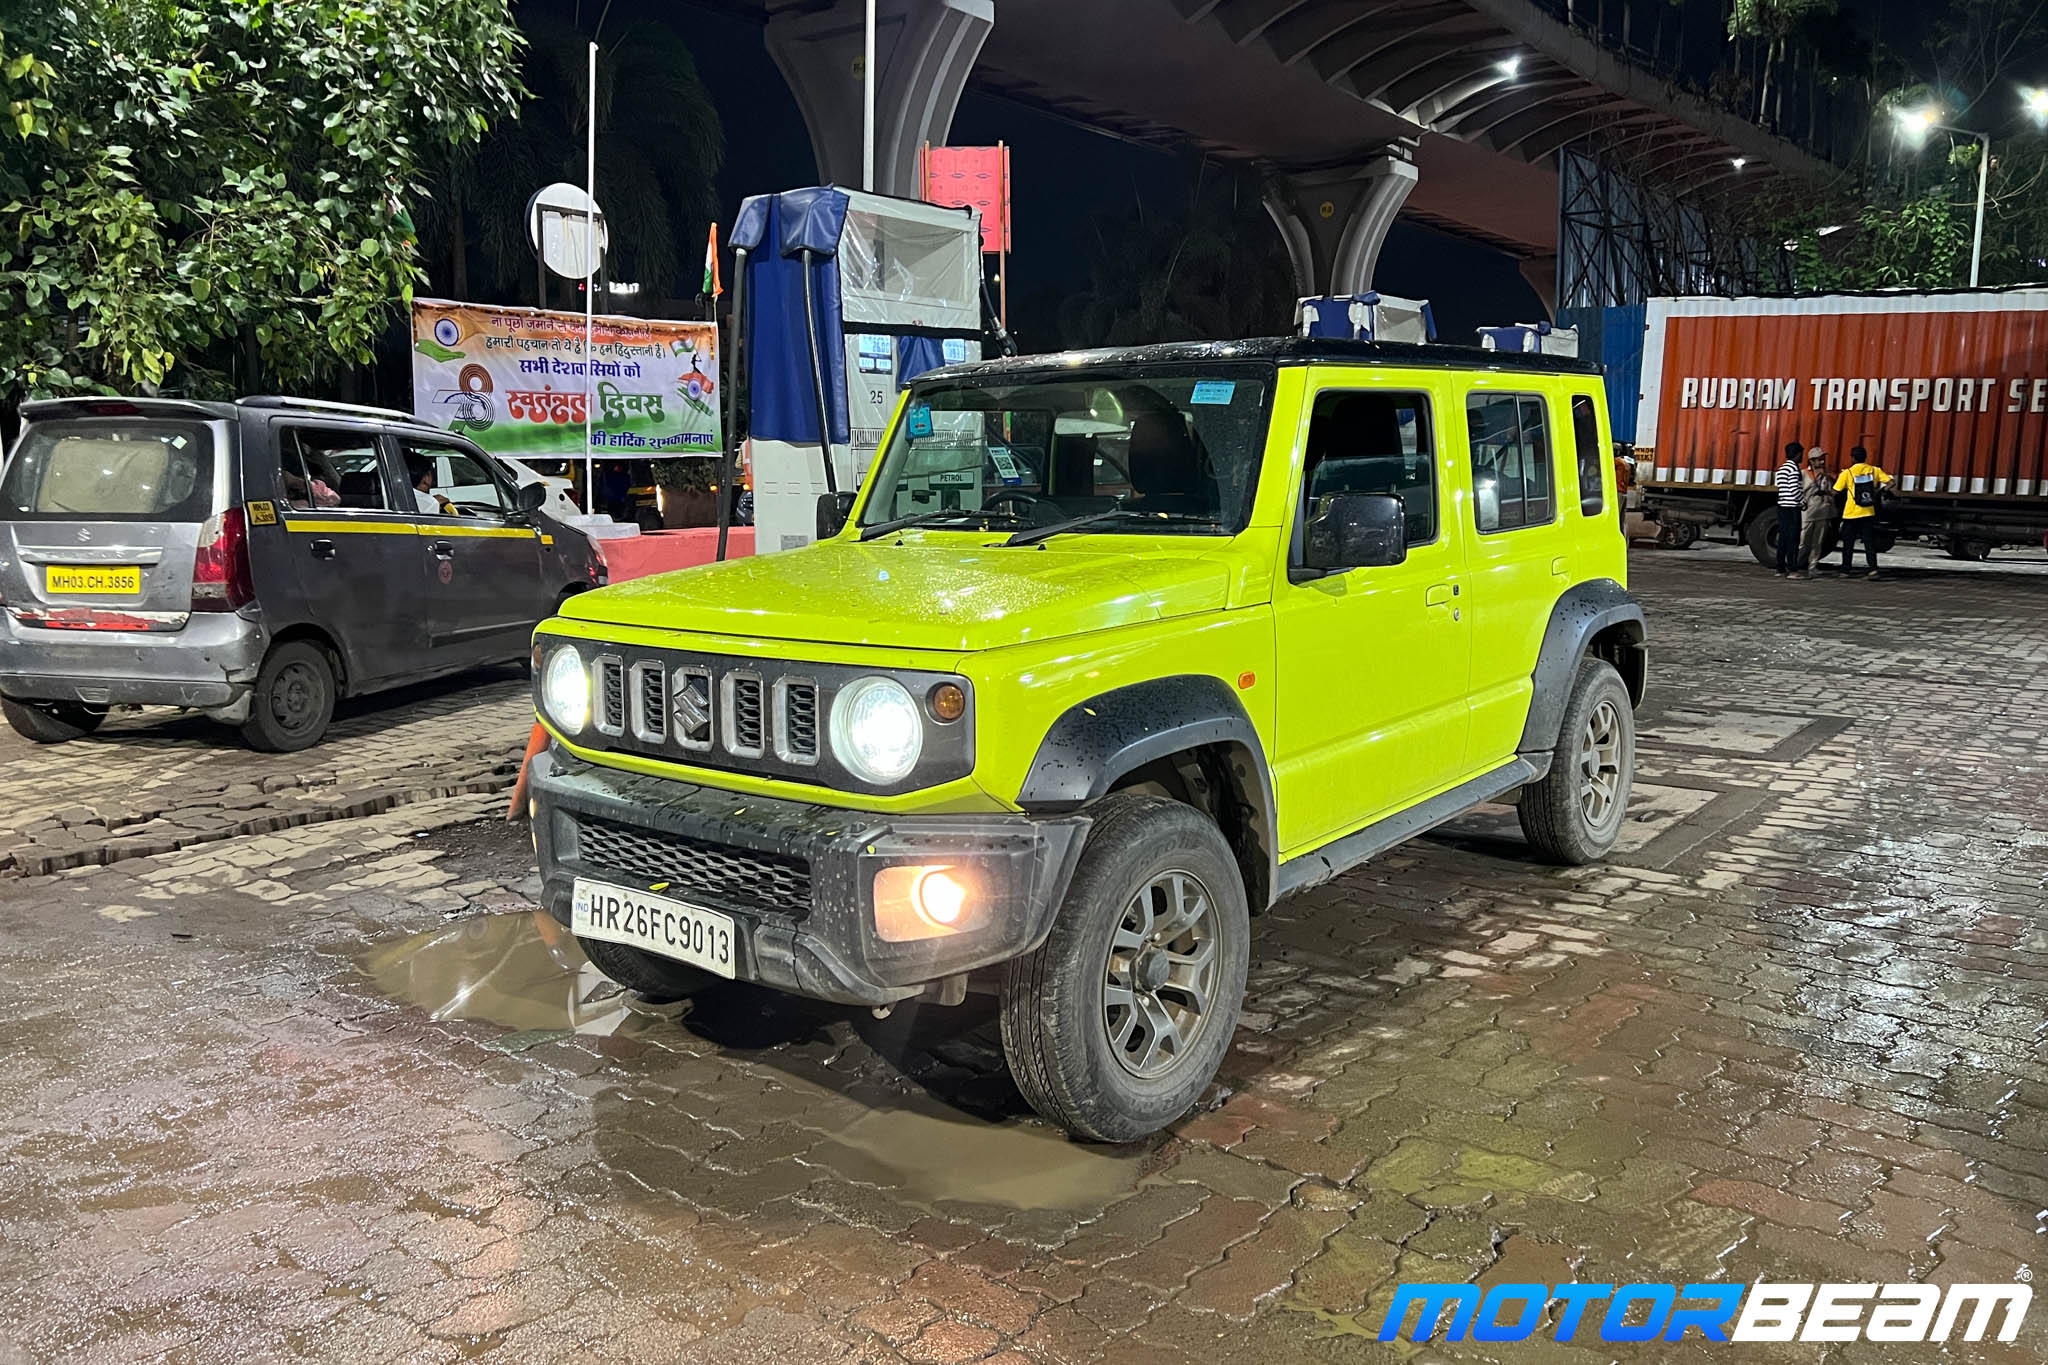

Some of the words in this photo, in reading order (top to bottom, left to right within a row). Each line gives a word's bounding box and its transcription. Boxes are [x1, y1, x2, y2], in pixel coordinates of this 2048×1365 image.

[485, 335, 513, 350] हमारी
[516, 337, 549, 352] पहचान
[551, 337, 562, 351] तो
[564, 338, 572, 351] ये
[574, 336, 582, 354] है
[599, 343, 613, 356] हम
[519, 357, 549, 375] सभी
[623, 361, 641, 378] को
[597, 381, 665, 426] दिवस
[870, 390, 883, 404] 25
[1681, 377, 1797, 411] RUDRAM
[1810, 377, 1997, 413] TRANSPORT
[609, 431, 645, 447] हार्दिक
[940, 473, 963, 482] PETROL
[51, 575, 135, 589] MH03.CH.3856
[575, 902, 589, 913] IND
[591, 894, 730, 965] HR26FC9013
